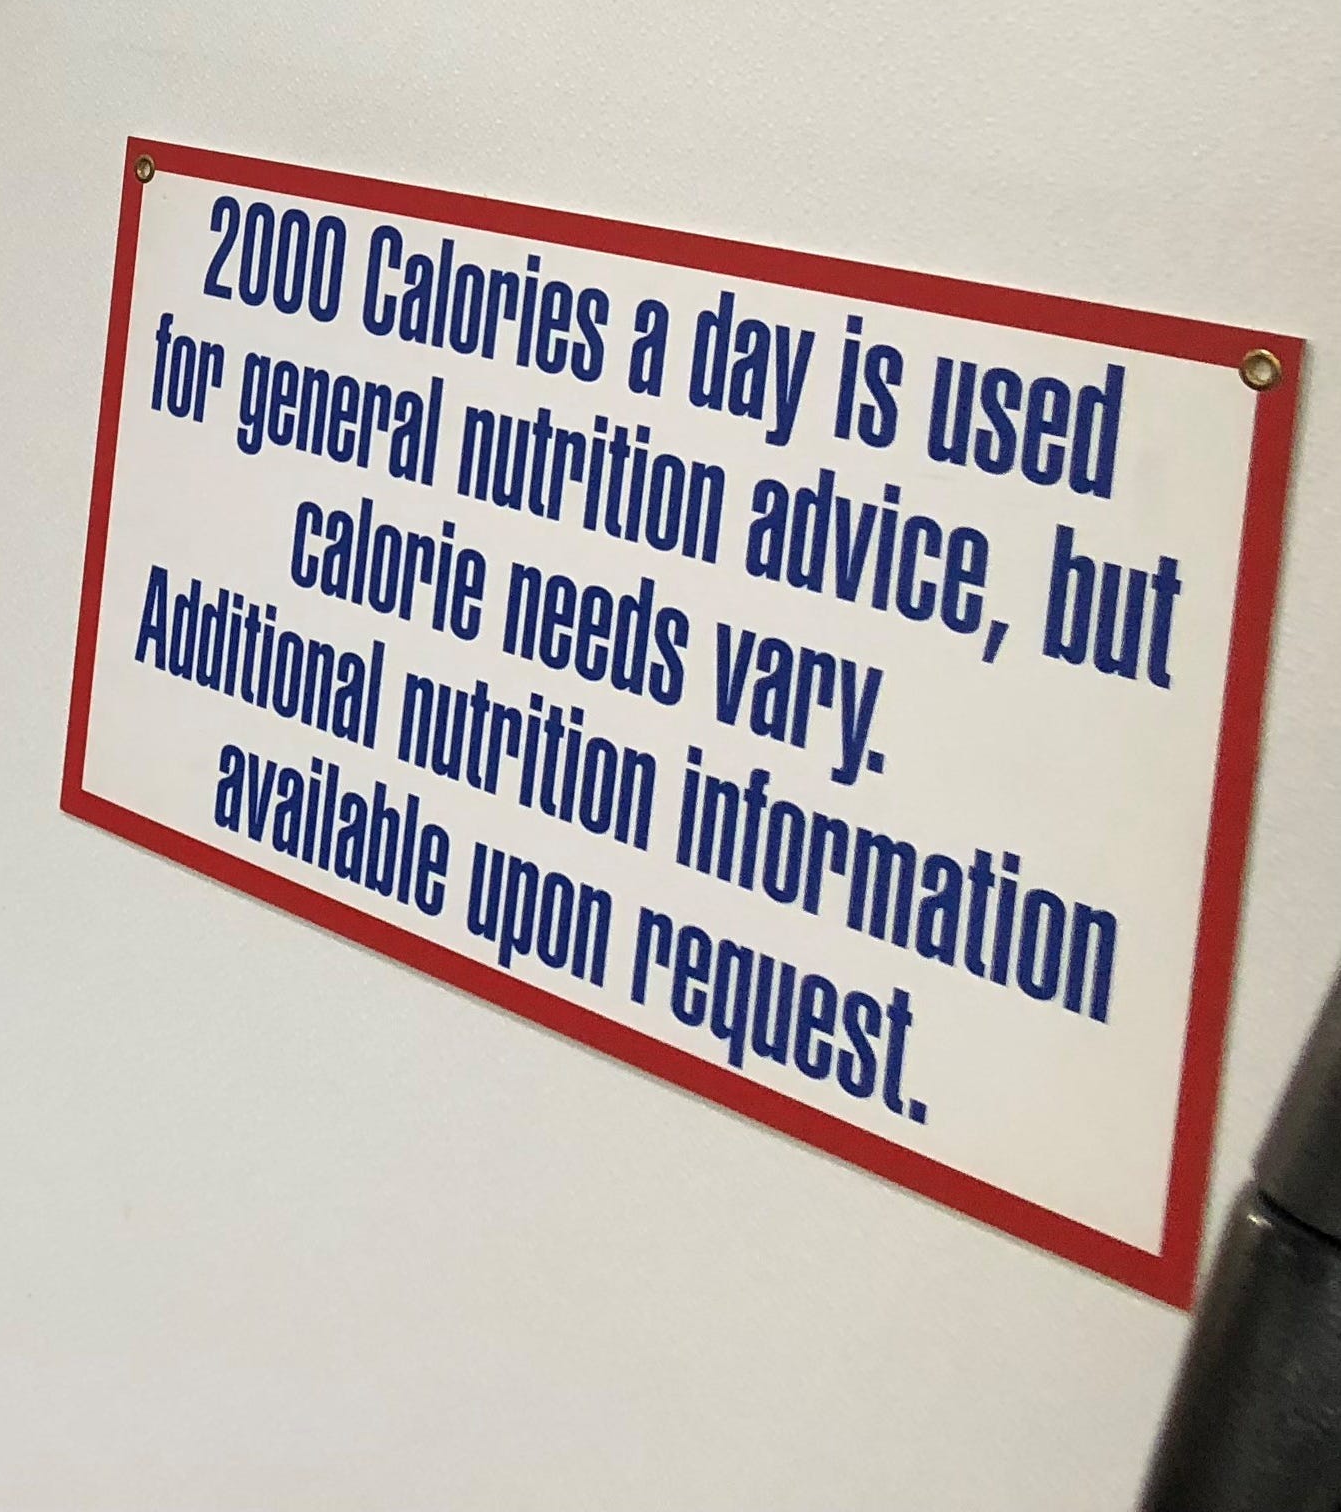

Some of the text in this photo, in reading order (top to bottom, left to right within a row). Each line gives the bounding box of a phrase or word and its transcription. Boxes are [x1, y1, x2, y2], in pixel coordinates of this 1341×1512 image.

[152, 313, 1181, 688] for general nutrition advice, but
[204, 196, 1125, 499] 2000 Calories a day is used
[135, 566, 1117, 1026] Additional nutrition information
[291, 498, 884, 785] calorie needs vary.
[215, 745, 927, 1124] available upon request.
